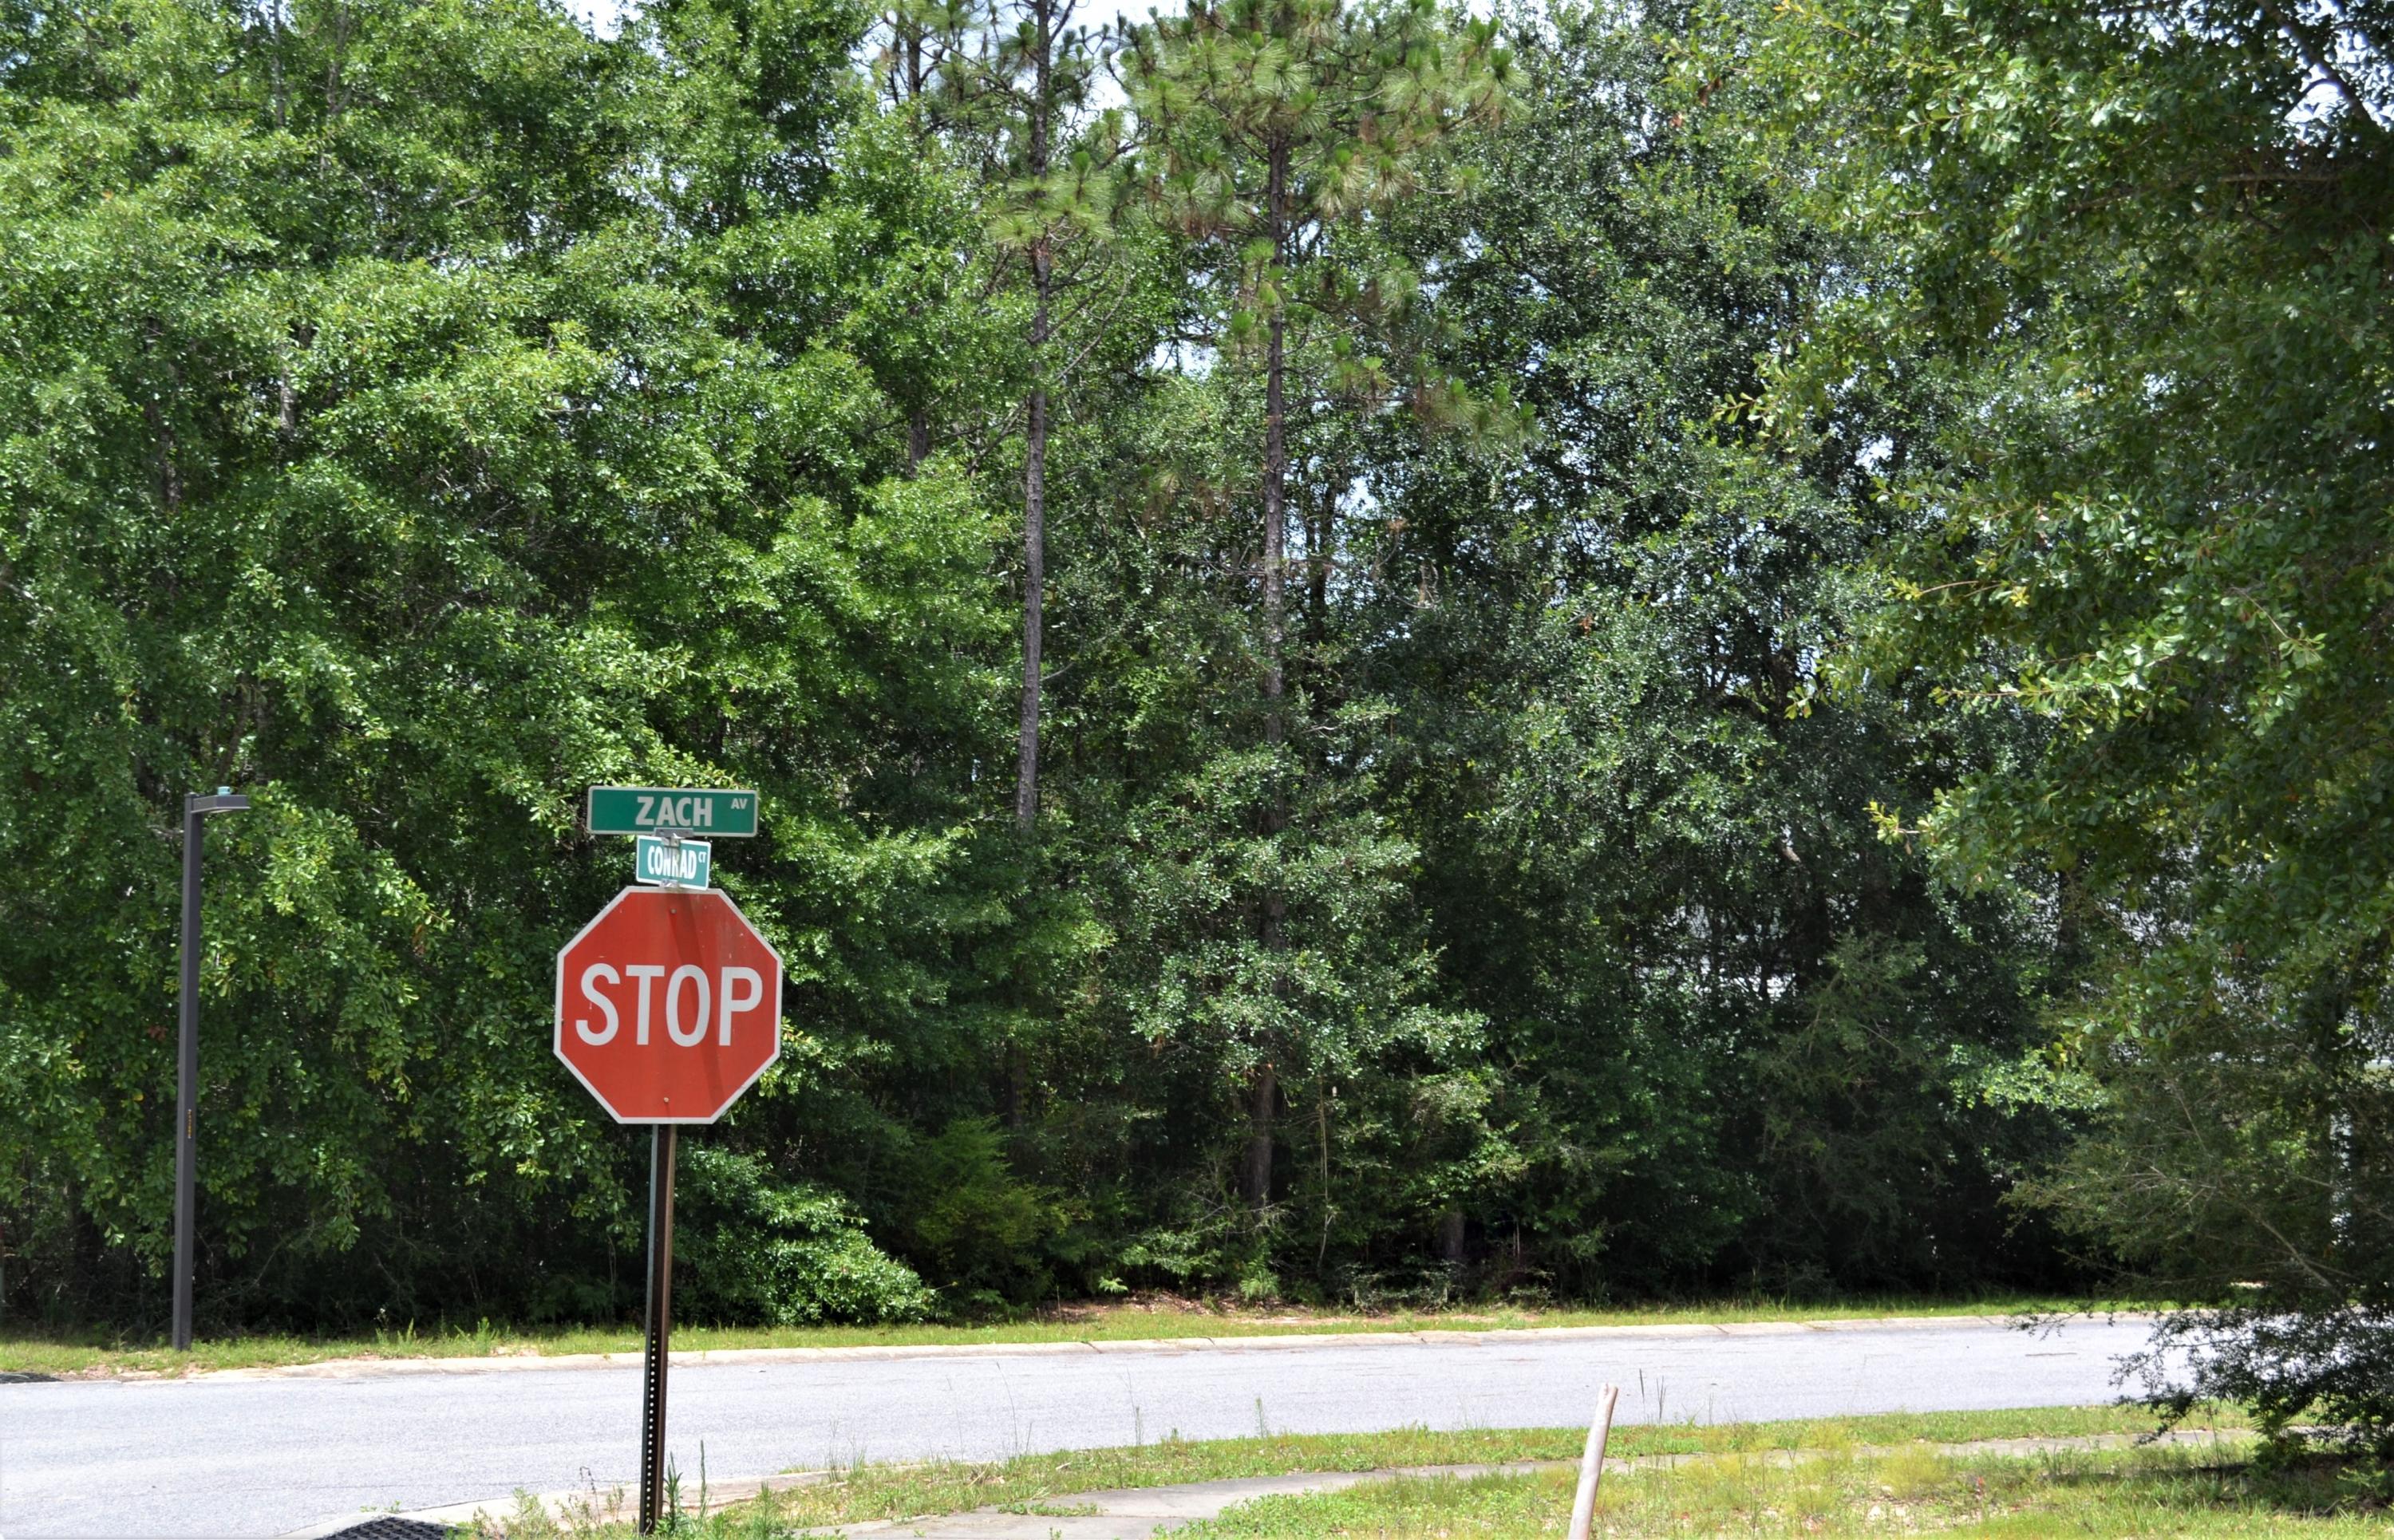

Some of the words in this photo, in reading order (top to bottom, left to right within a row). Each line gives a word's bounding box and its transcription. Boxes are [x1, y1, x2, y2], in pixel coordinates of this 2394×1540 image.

[636, 796, 713, 827] ZACH
[731, 798, 748, 809] AV
[698, 851, 707, 863] CT
[575, 963, 763, 1047] STOP
